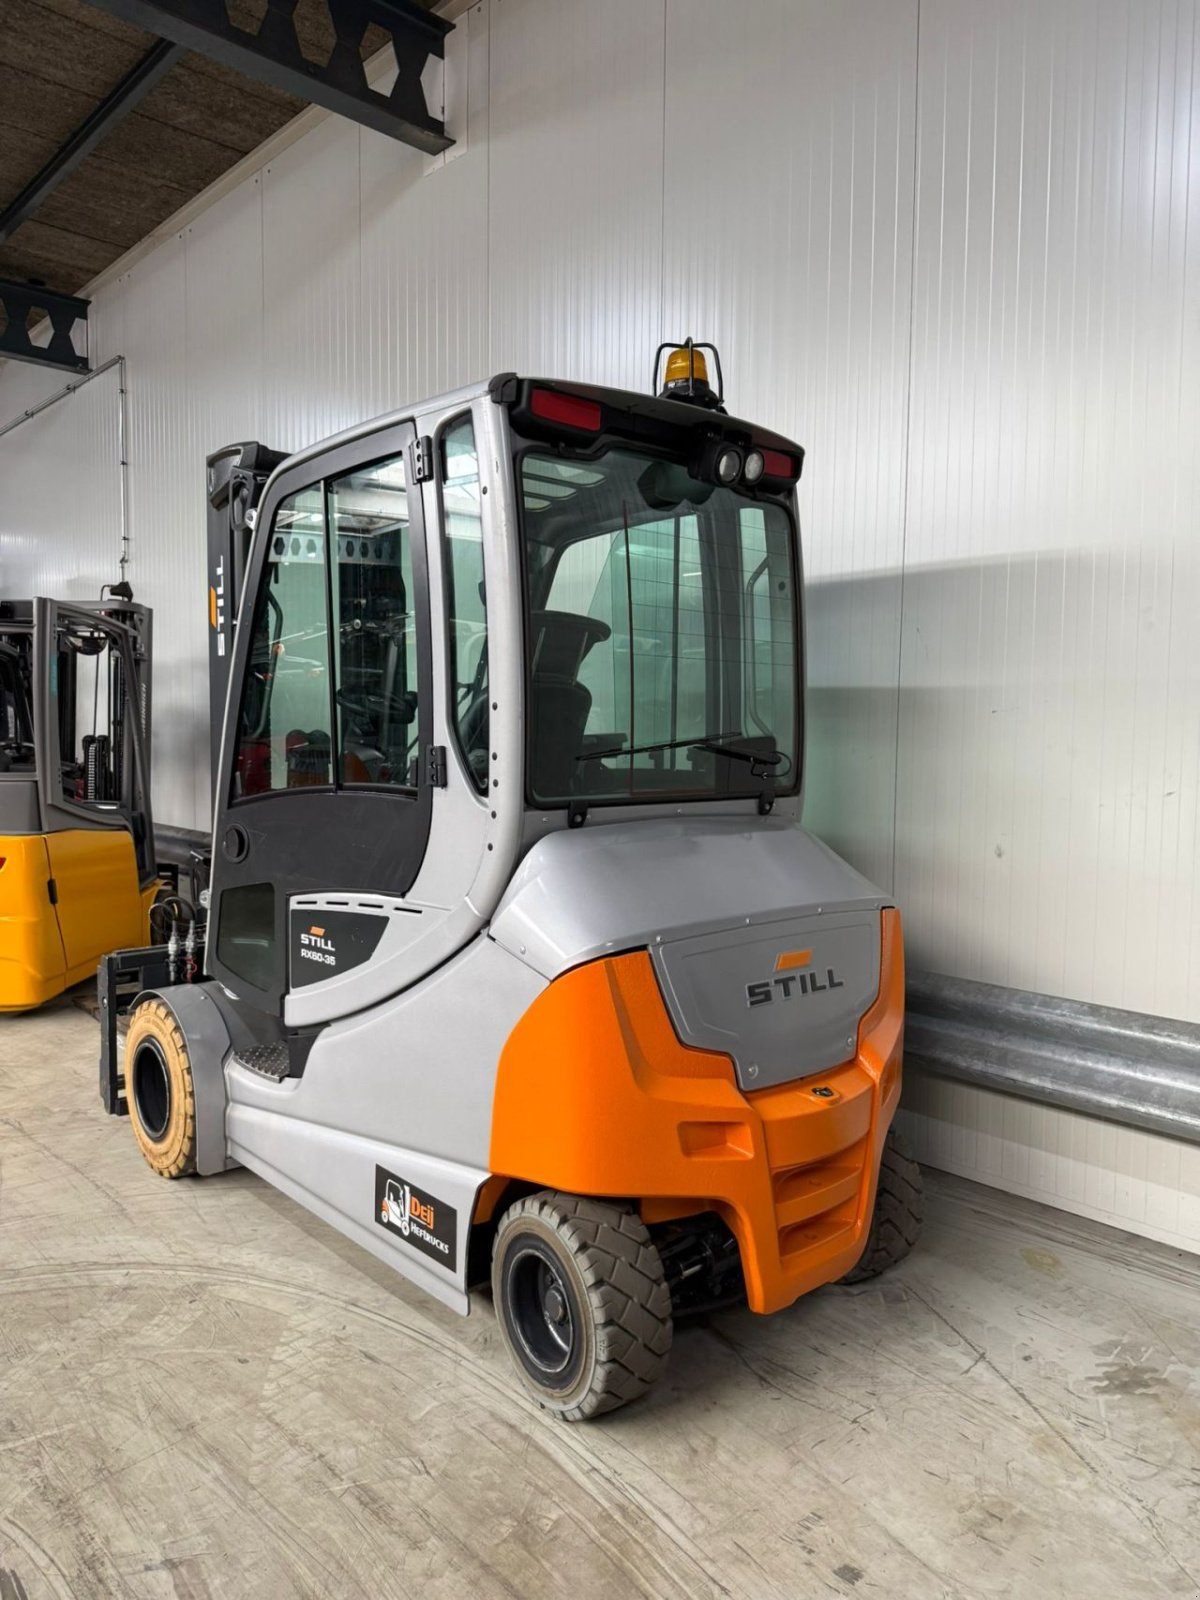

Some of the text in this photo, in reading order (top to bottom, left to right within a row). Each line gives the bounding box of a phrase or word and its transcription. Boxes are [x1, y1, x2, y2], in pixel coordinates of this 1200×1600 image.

[216, 554, 225, 656] STILL
[300, 933, 336, 952] STILL
[300, 948, 336, 966] RX60-35
[745, 968, 844, 1008] STILL
